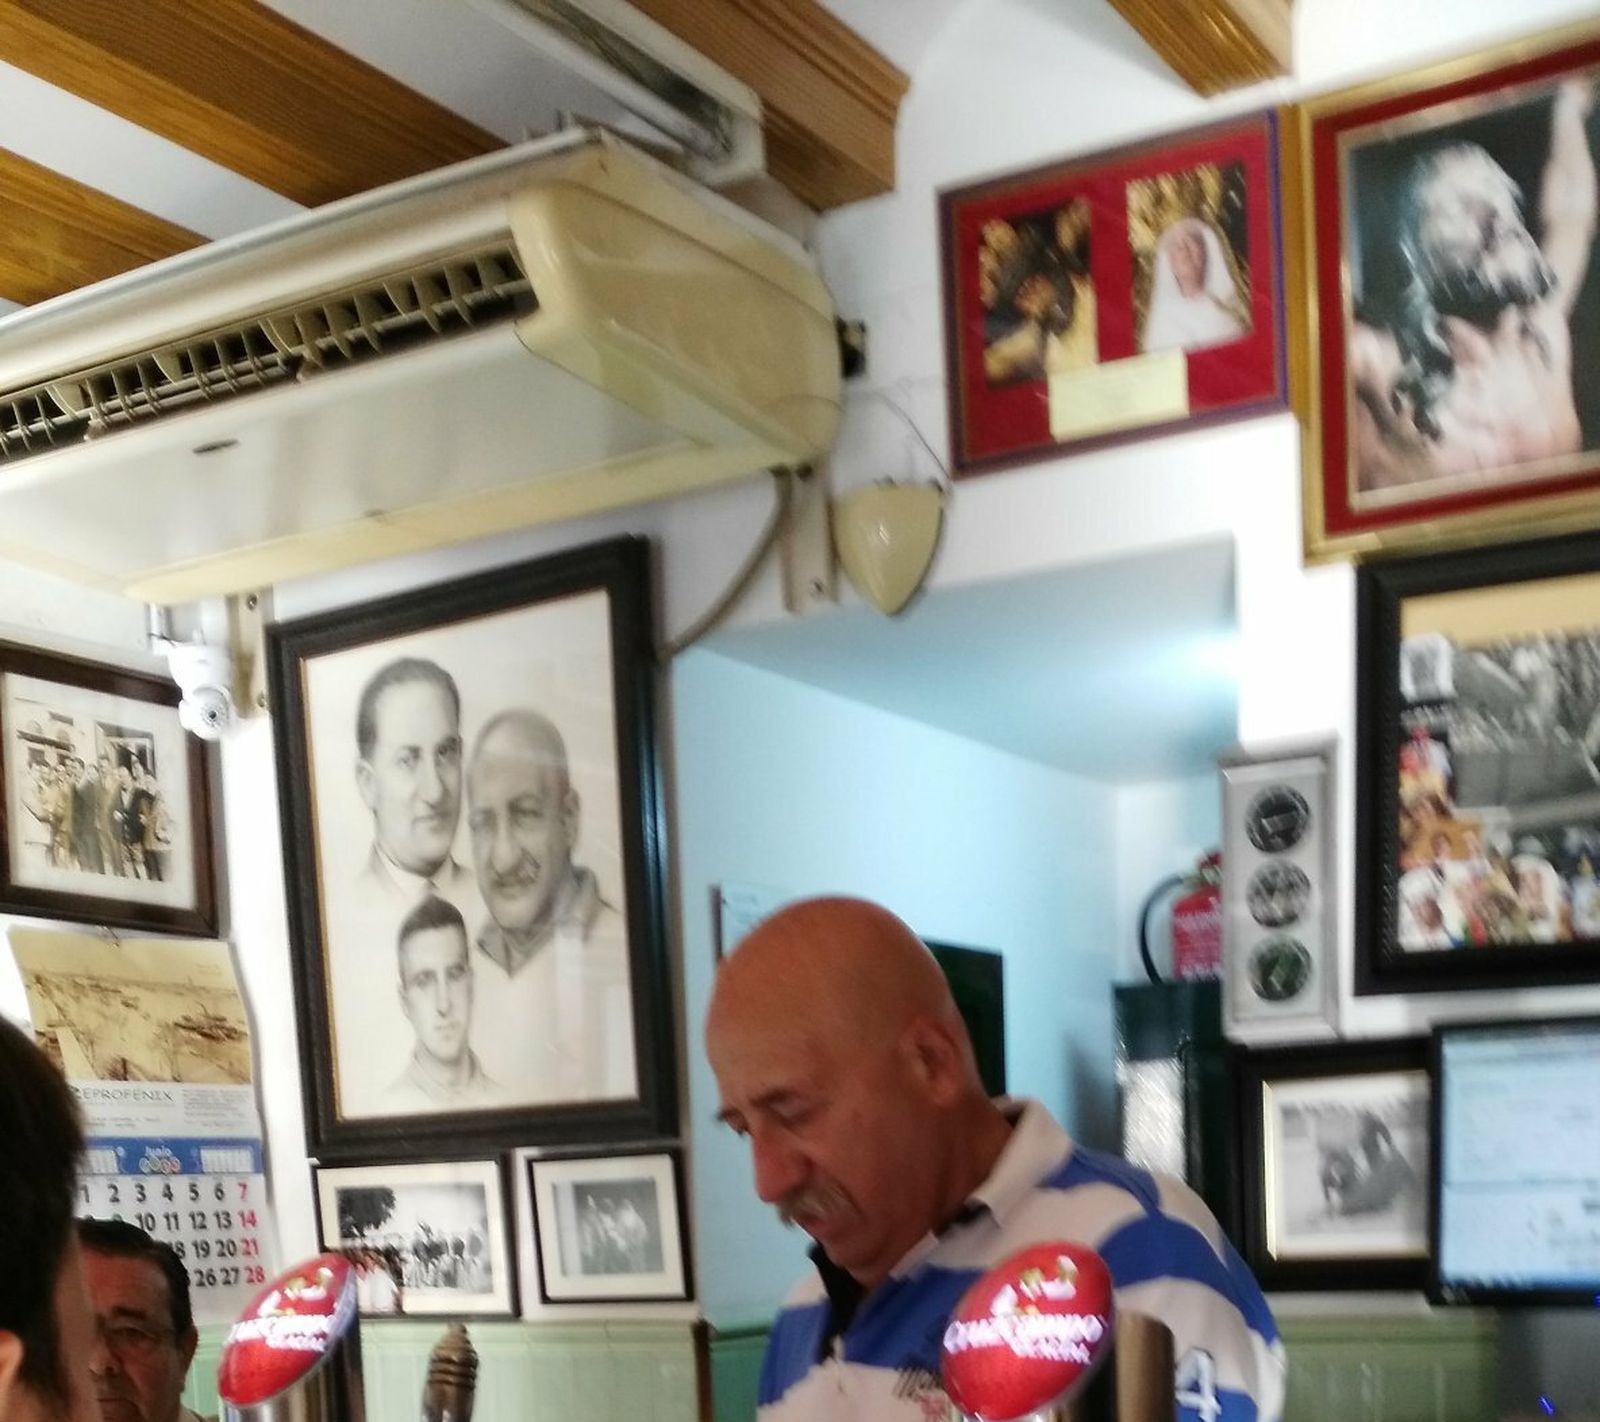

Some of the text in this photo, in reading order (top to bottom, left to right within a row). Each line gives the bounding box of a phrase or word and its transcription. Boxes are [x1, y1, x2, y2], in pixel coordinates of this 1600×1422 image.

[79, 1182, 248, 1204] 1 2 3 4 5 6 7
[135, 1212, 156, 1232] 10
[163, 1211, 180, 1231] 11
[188, 1210, 207, 1230] 12
[213, 1210, 232, 1230] 13
[238, 1209, 258, 1228] 14
[192, 1240, 210, 1258] 19
[215, 1238, 237, 1257] 20
[240, 1238, 259, 1256] 21
[195, 1265, 266, 1287] 26 27 28
